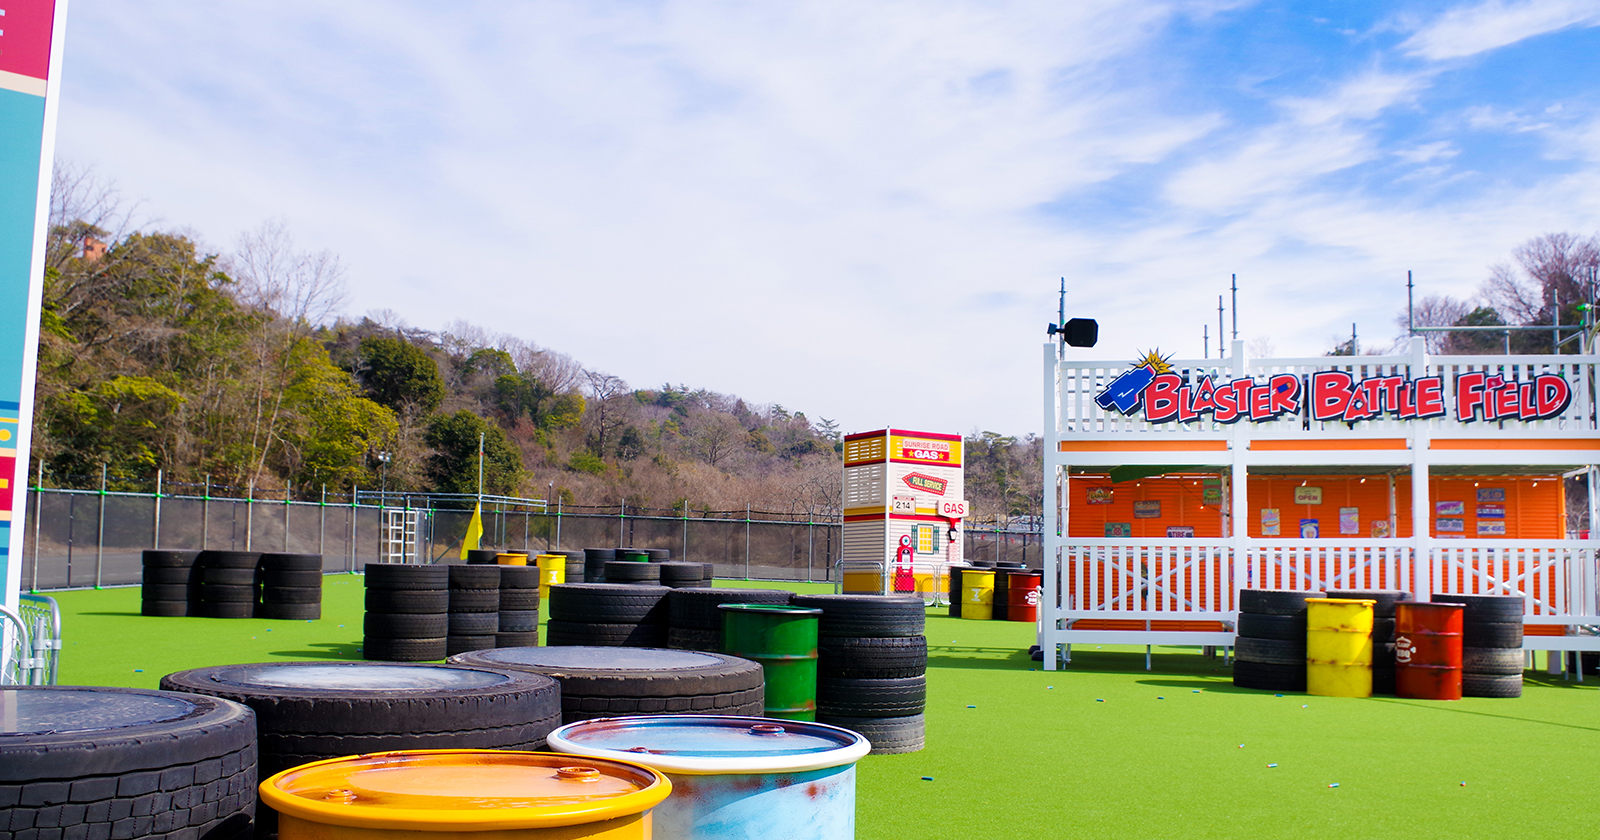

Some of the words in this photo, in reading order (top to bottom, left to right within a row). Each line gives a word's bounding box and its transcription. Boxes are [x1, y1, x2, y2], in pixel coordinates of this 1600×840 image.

[1145, 373, 1300, 424] BLASTER
[1312, 370, 1445, 421] BATTLE
[1456, 371, 1571, 422] FIELD
[904, 440, 930, 449] SUNRISE
[914, 449, 938, 460] GAS
[912, 476, 923, 487] FULL
[923, 479, 943, 491] SERVICE
[943, 502, 964, 514] GAS
